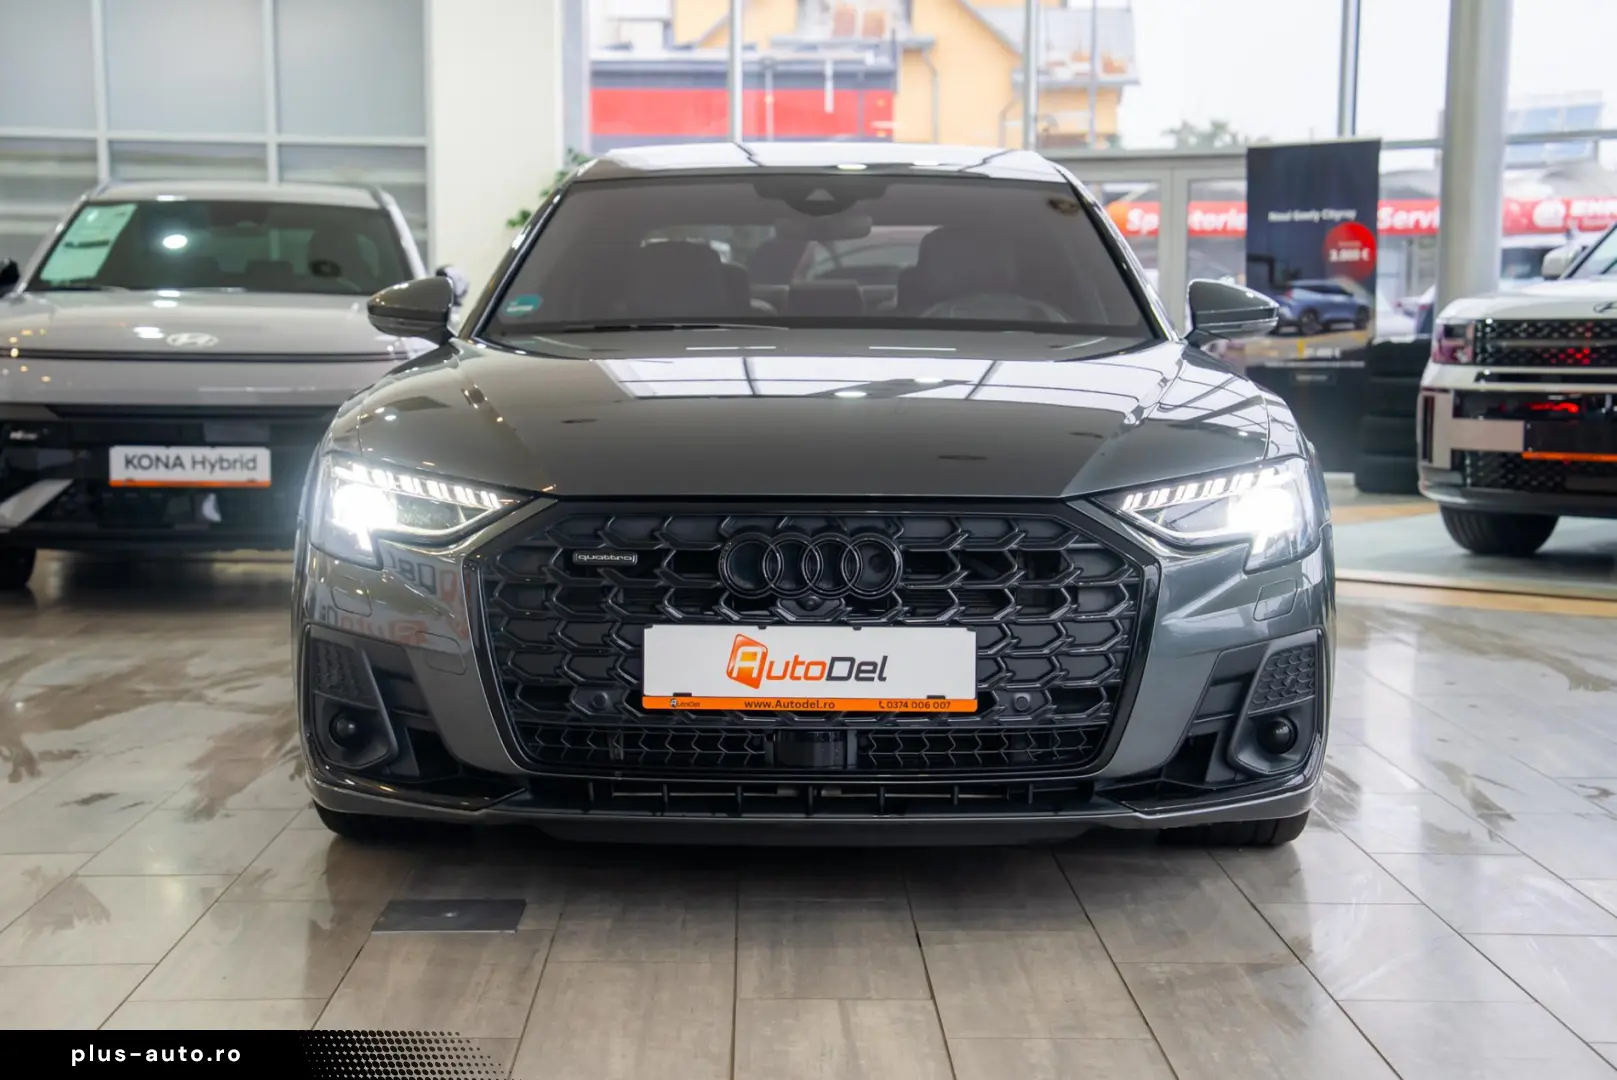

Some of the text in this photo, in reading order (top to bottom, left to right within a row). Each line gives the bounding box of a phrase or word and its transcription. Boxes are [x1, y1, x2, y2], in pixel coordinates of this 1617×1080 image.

[124, 453, 257, 475] KONA Hybrid
[578, 554, 633, 562] quattro
[727, 637, 888, 686] AutoDel
[744, 699, 836, 709] www.Autodel.ro
[886, 701, 951, 709] 0374 006 007
